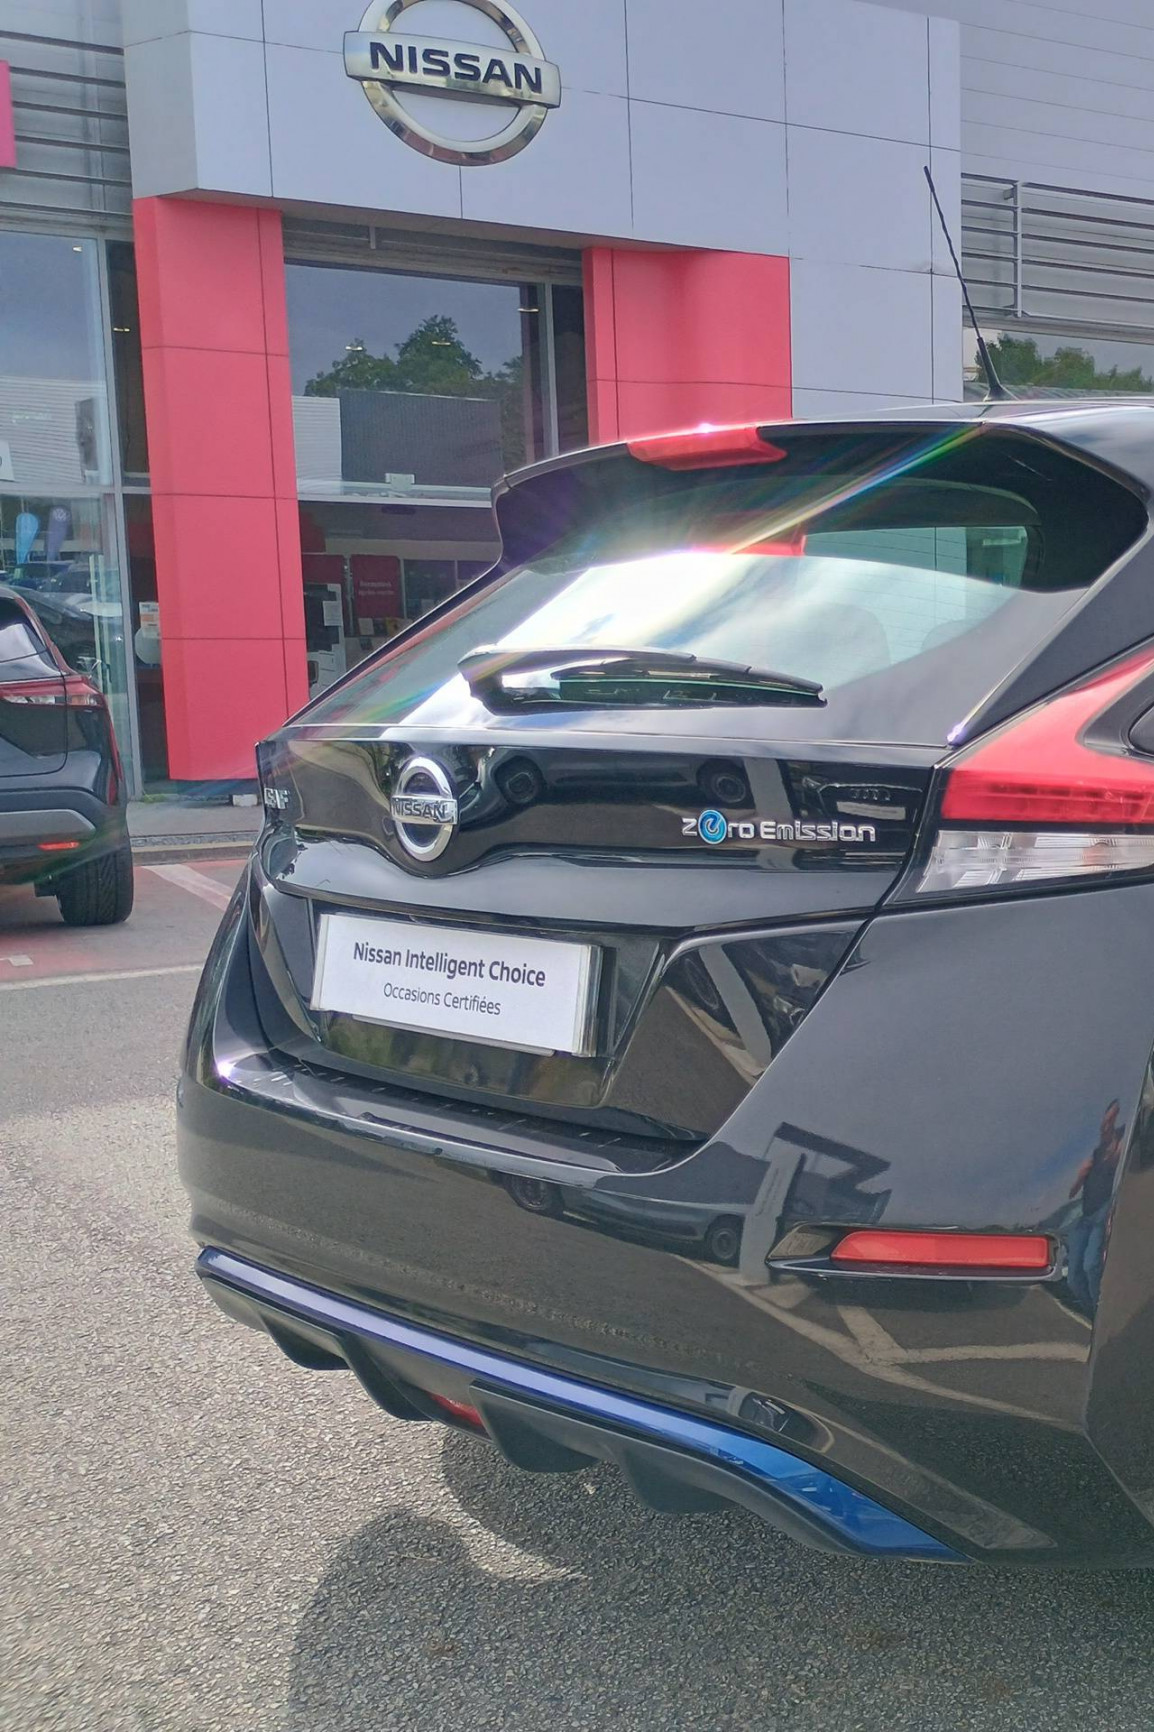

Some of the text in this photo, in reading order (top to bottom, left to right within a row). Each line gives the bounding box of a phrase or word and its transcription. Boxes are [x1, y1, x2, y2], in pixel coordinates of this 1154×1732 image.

[369, 41, 543, 94] NISSAN
[392, 801, 448, 822] NISSAN
[759, 819, 877, 842] Emission
[353, 941, 546, 987] Nissan Intelligent Choice
[383, 982, 501, 1016] Occasions Certifiées
